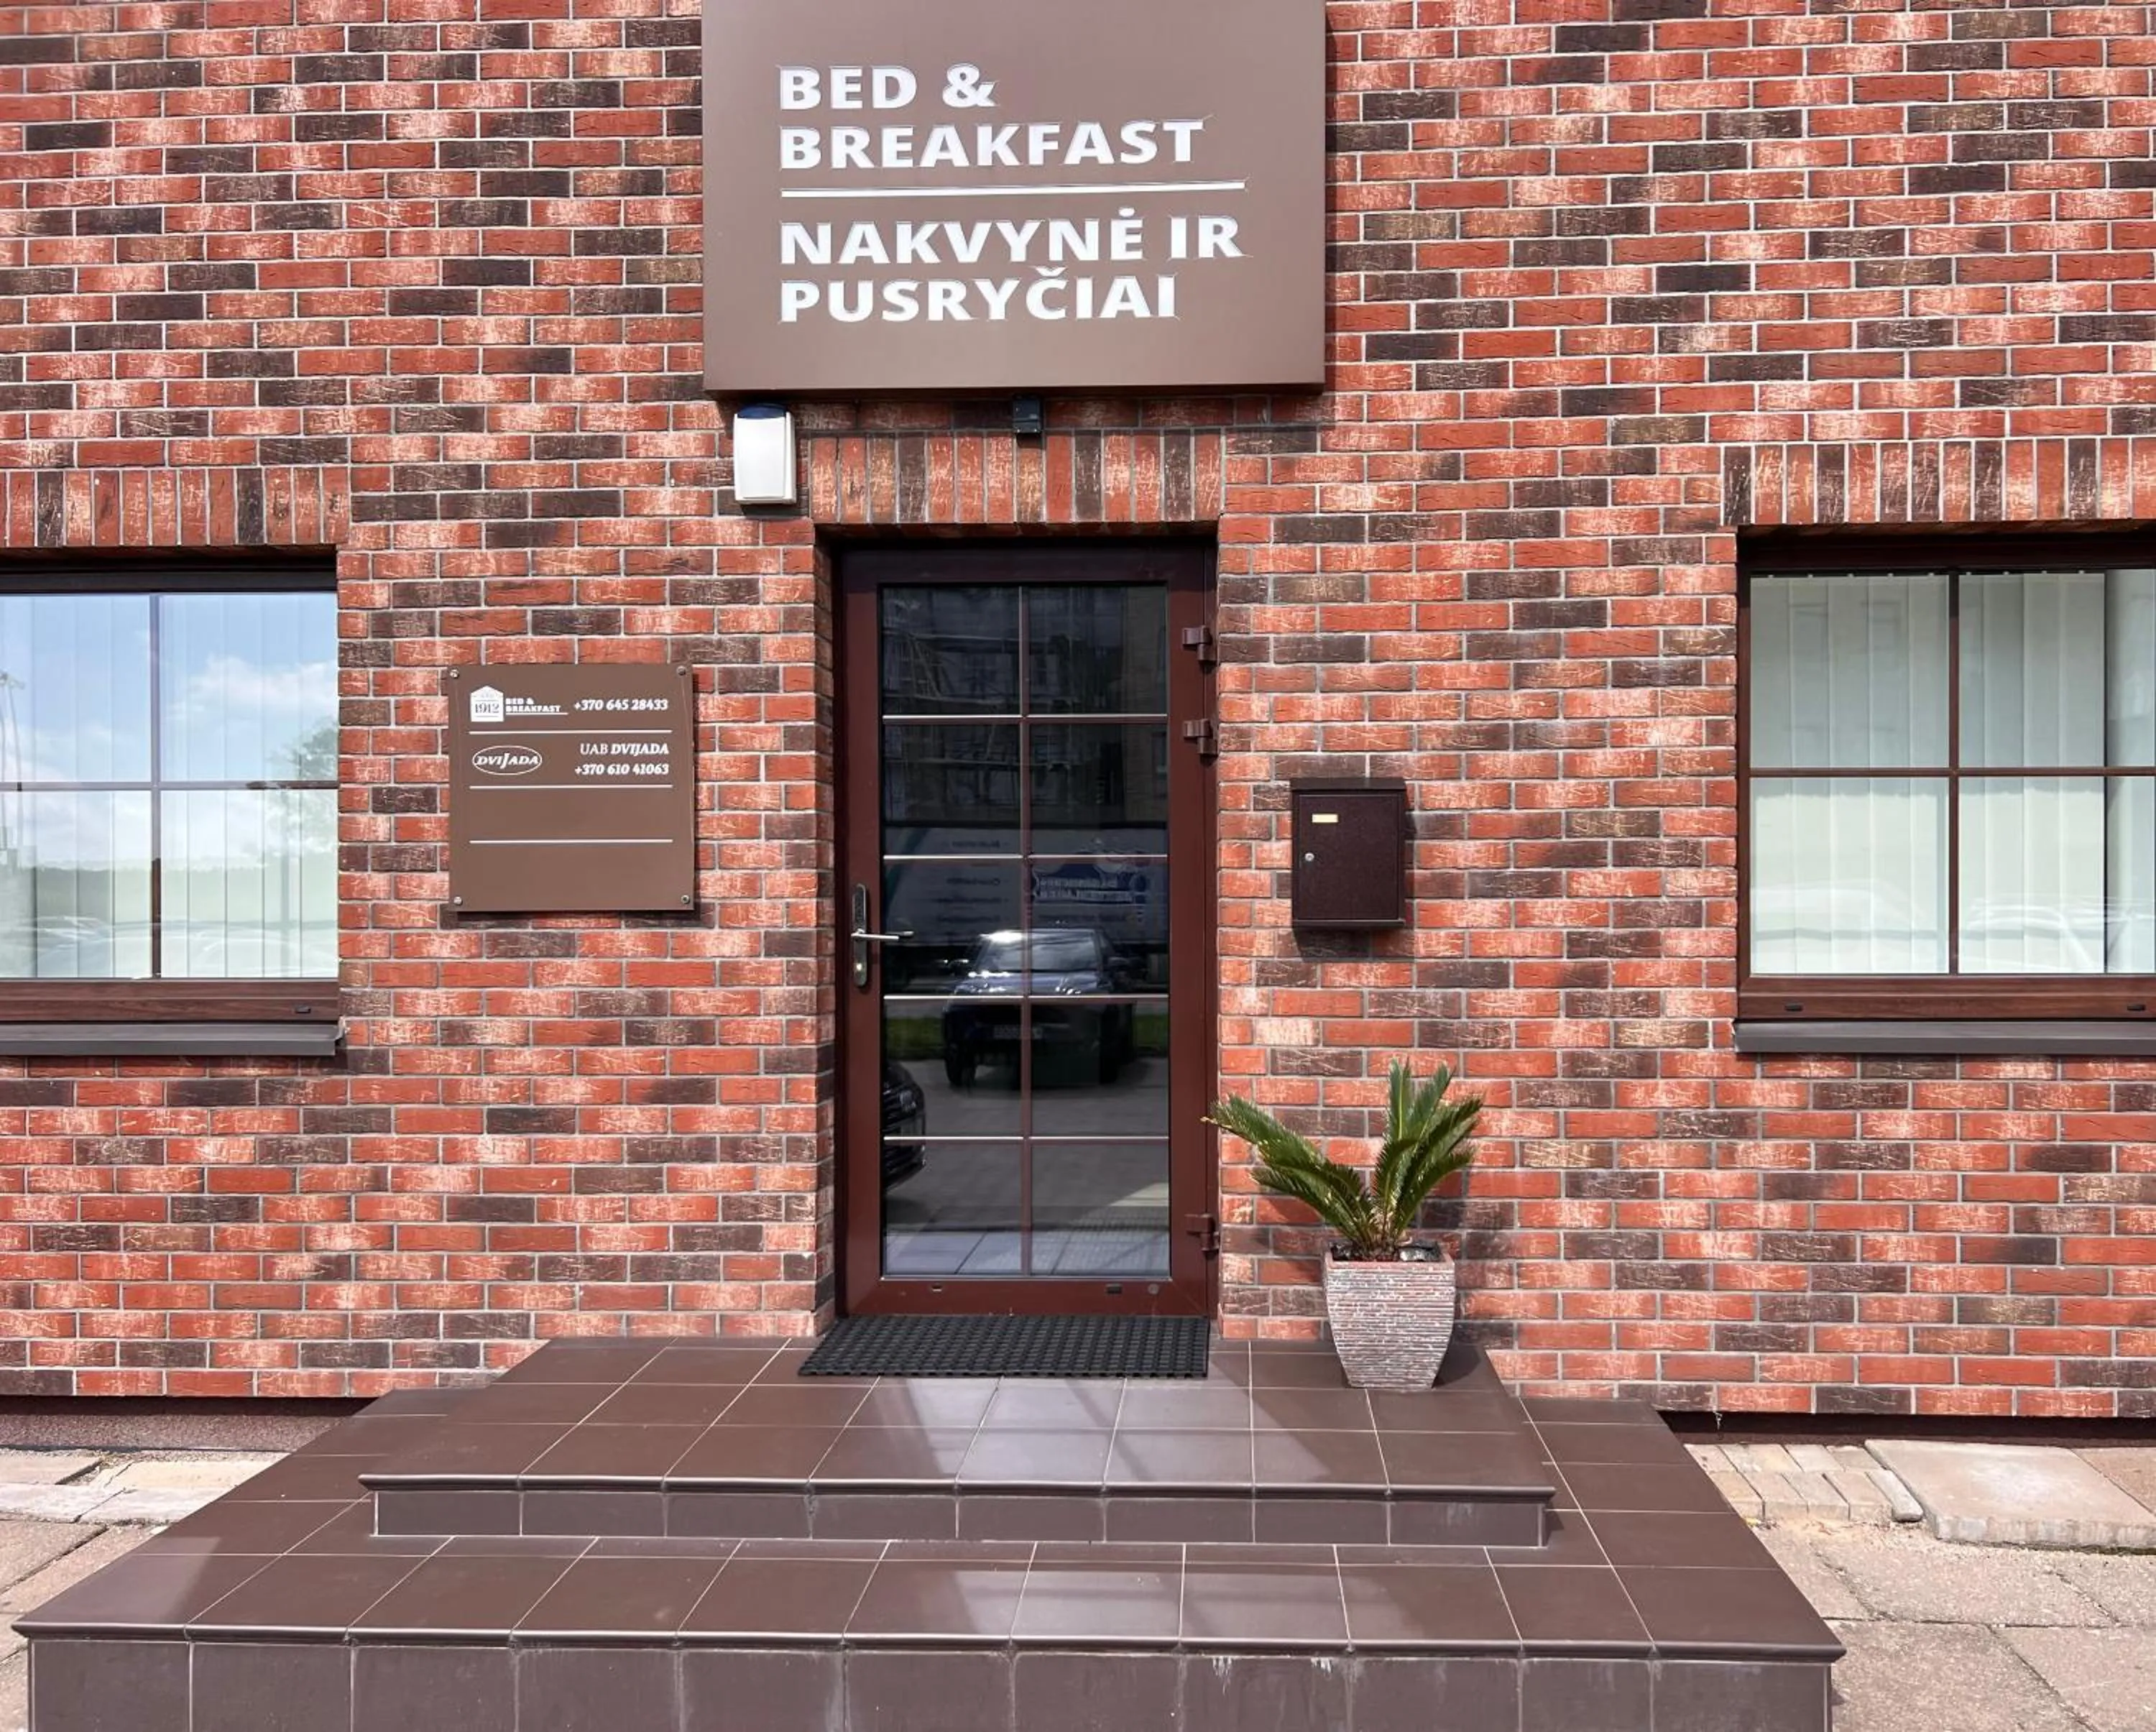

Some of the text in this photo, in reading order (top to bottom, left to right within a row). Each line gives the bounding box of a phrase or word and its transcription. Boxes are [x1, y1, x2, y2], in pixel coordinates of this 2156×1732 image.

[779, 63, 998, 110] BED &
[780, 118, 1205, 169] BREAKFAST
[780, 207, 1245, 264] NAKVYNĖ IR
[780, 266, 1176, 322] PUSRYČIAI
[475, 702, 499, 713] 1912
[574, 699, 668, 710] +370 645 28433
[580, 743, 669, 757] UAB DVIJADA
[476, 752, 538, 769] DVIJADA
[575, 763, 669, 775] +370 610 41063
